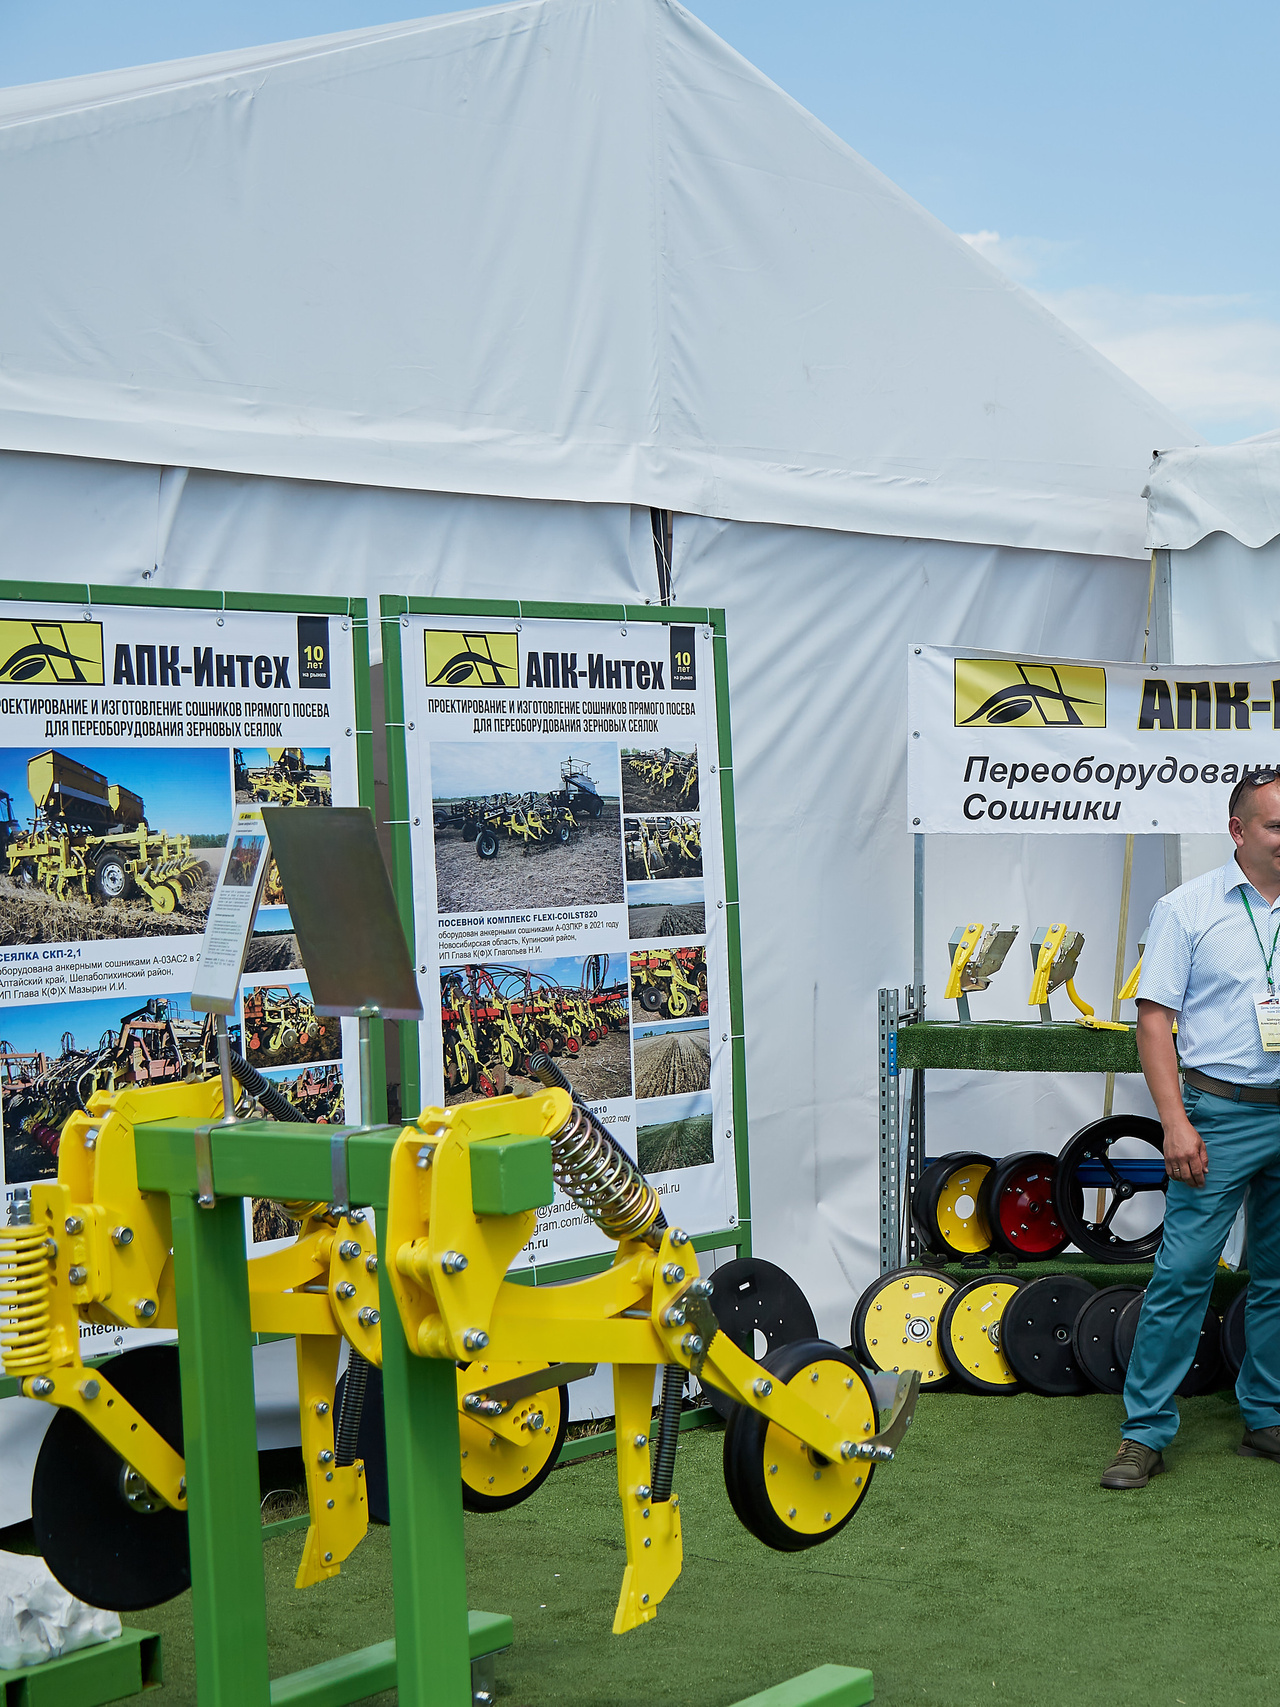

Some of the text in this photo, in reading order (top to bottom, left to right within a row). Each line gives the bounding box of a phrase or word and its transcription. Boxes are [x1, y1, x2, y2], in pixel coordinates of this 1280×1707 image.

[304, 645, 324, 661] 10
[675, 651, 691, 666] 10
[113, 643, 291, 689] АПК-Интех
[526, 651, 665, 690] АПК-Интех
[0, 698, 330, 718] ОЕКТИРОВАНИЕ И ИЗГОТОВЛЕНИЕ СОШНИКОВ ПРЯМОГО ПОСЕВА
[428, 699, 696, 716] ПРОЕКТИРОВАНИЕ И ИЗГОТОВЛЕНИЕ СОШНИКОВ ПРЯМОГО ПОСЕВА
[45, 720, 283, 738] ДЛЯ ПЕРЕОБОРУДОВАНИЯ ЗЕРНОВЫХ СЕЯЛОК
[473, 718, 659, 734] ДЛЯ ПЕРЕОБОРУДОВАНИЯ ЗЕРНОВЫХ СЕЯЛОК
[963, 793, 1122, 821] Сошники
[438, 910, 598, 928] ПОСЕВНОЙ КОМПЛЕКС FLEXI-COILST820
[438, 930, 479, 940] оборудован
[480, 928, 517, 937] анкерными
[517, 926, 554, 934] сошниками
[589, 920, 604, 929] 2021
[605, 921, 620, 930] году
[438, 940, 490, 949] Новосибирская
[521, 934, 554, 945] Купинский
[42, 948, 81, 960] СКП-2,1
[438, 951, 450, 960] ИП
[451, 951, 472, 959] Глава
[528, 945, 543, 954] Н.И.
[0, 965, 53, 977] борудована
[55, 961, 103, 972] анкерными
[104, 958, 151, 968] сошниками
[45, 975, 67, 985] край,
[69, 968, 145, 983] Шелаболихинский
[147, 968, 174, 979] район,
[13, 988, 39, 998] Глава
[41, 986, 67, 998] К(Ф)Х
[68, 983, 107, 995] Мазырин
[109, 981, 127, 991] И.И.
[601, 1114, 631, 1124] 2022 году
[654, 1183, 680, 1196] ail.ru
